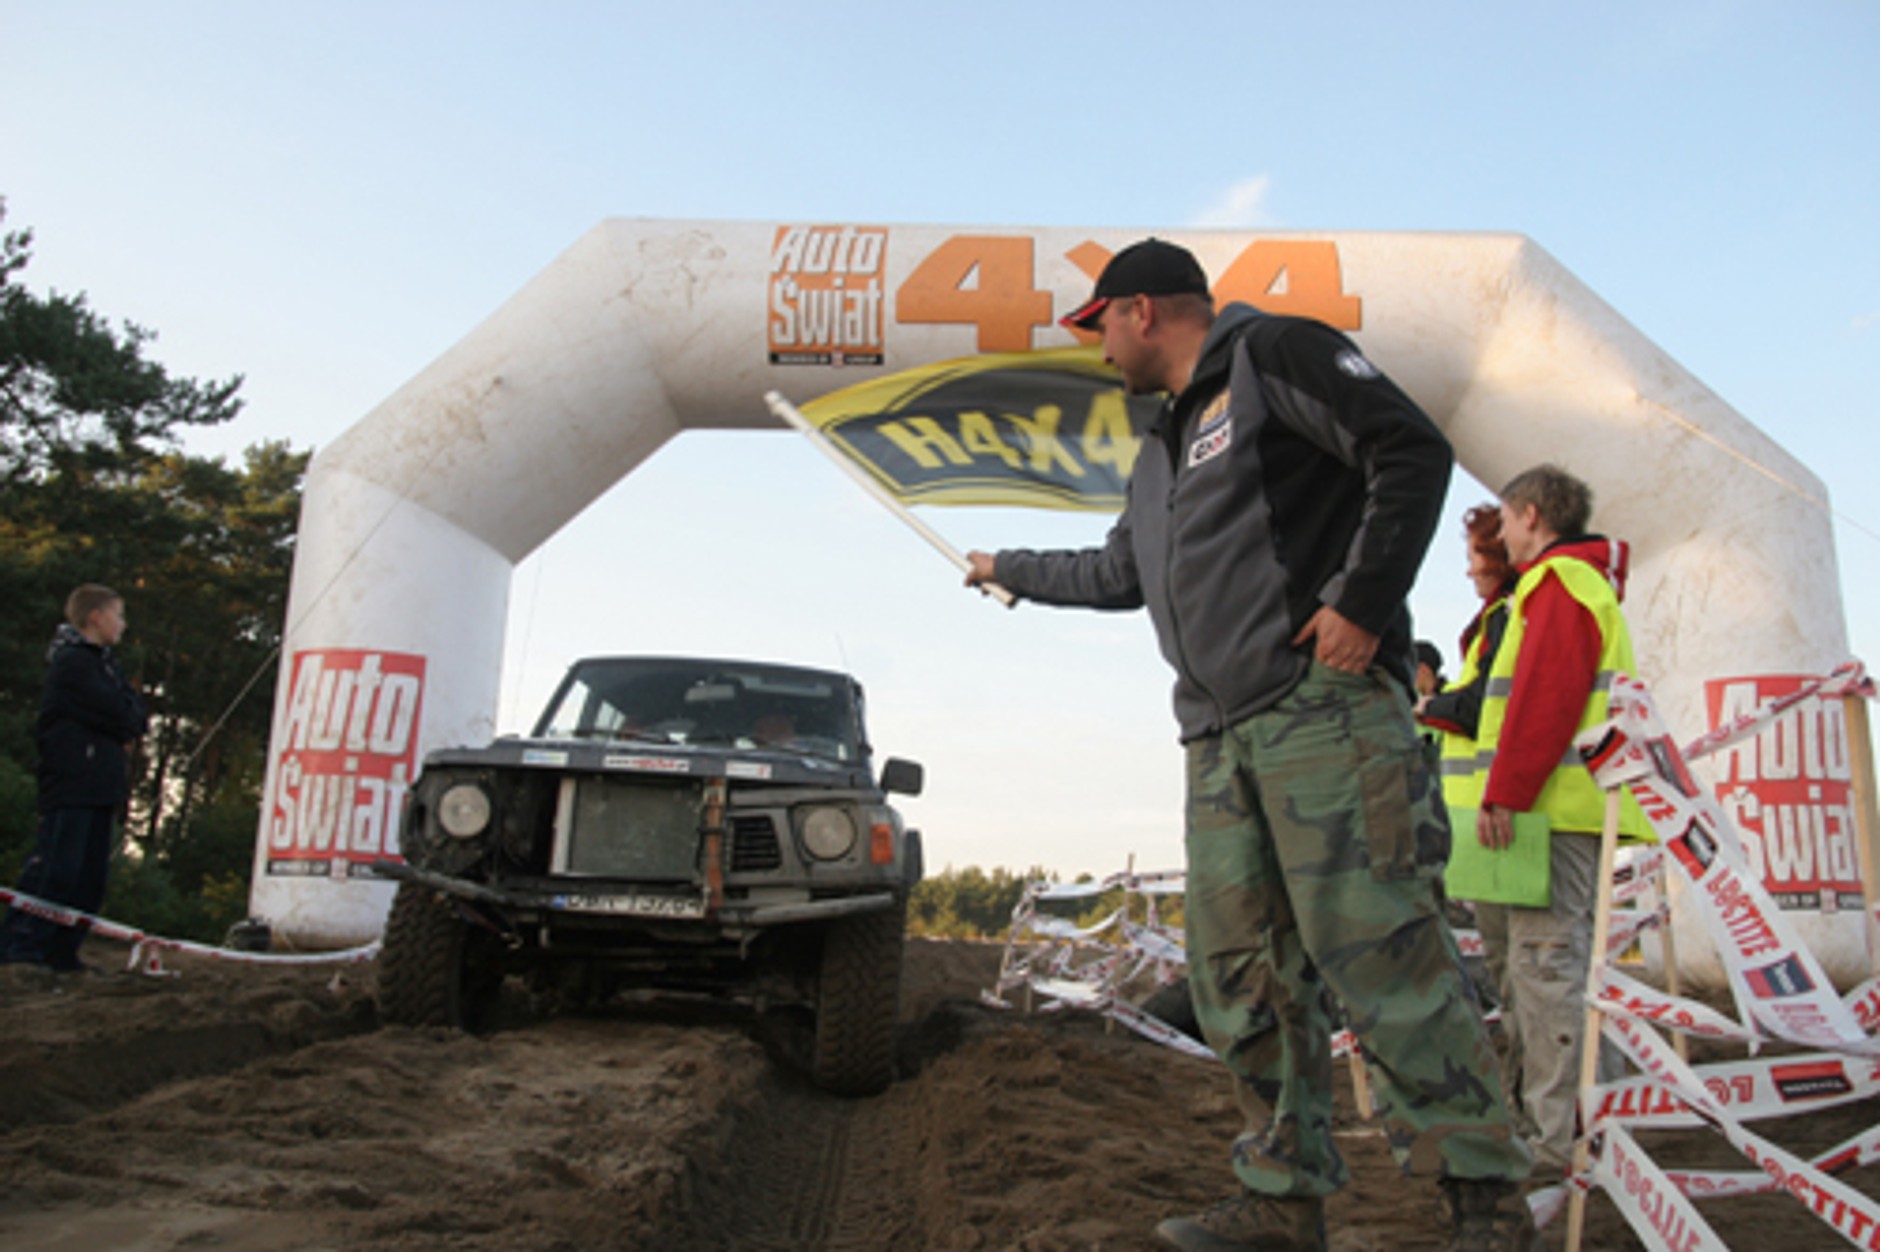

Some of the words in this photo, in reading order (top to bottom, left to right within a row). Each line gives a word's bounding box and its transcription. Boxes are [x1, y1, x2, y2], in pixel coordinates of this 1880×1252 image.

[769, 225, 886, 274] Auto
[773, 273, 881, 347] Świat
[281, 654, 419, 754] Auto
[1713, 679, 1850, 781] Auto
[272, 754, 409, 855] Świat
